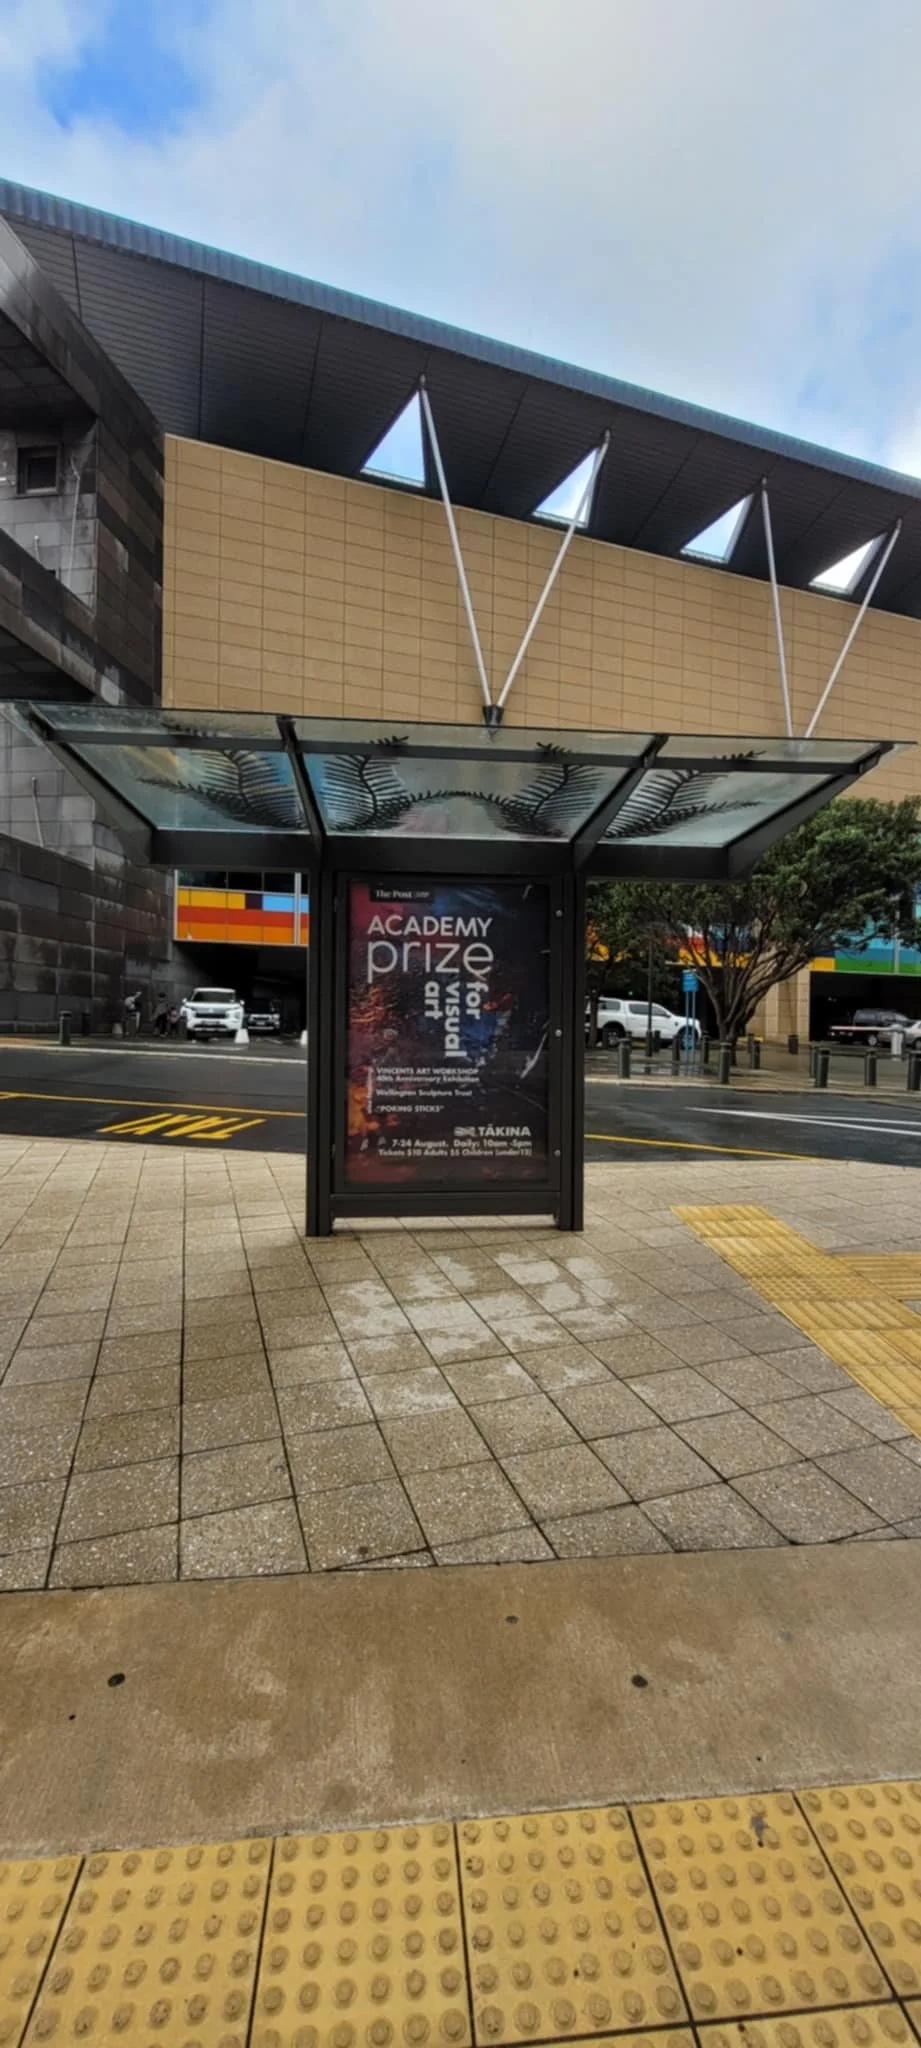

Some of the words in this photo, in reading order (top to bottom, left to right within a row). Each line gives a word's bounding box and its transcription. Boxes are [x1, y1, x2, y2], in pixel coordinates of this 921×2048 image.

[375, 889, 391, 898] The
[392, 889, 412, 898] Post
[367, 915, 493, 937] ACADEMY
[367, 940, 494, 984] prize
[424, 981, 443, 1020] art
[466, 981, 489, 1020] for
[444, 981, 467, 1058] visual
[376, 1067, 414, 1075] VINCENTS
[416, 1067, 431, 1075] ART
[432, 1067, 479, 1075] WORKSHOP
[396, 1076, 441, 1084] Anniversary
[376, 1089, 416, 1098] Wellington
[418, 1089, 453, 1098] Sculpture
[477, 1123, 532, 1137] TĀKINA
[453, 1139, 480, 1149] Daily:
[482, 1139, 508, 1147] 10am
[377, 1149, 405, 1157] Tickets
[407, 1149, 422, 1157] $10
[423, 1149, 448, 1157] Adults
[462, 1149, 493, 1157] Children
